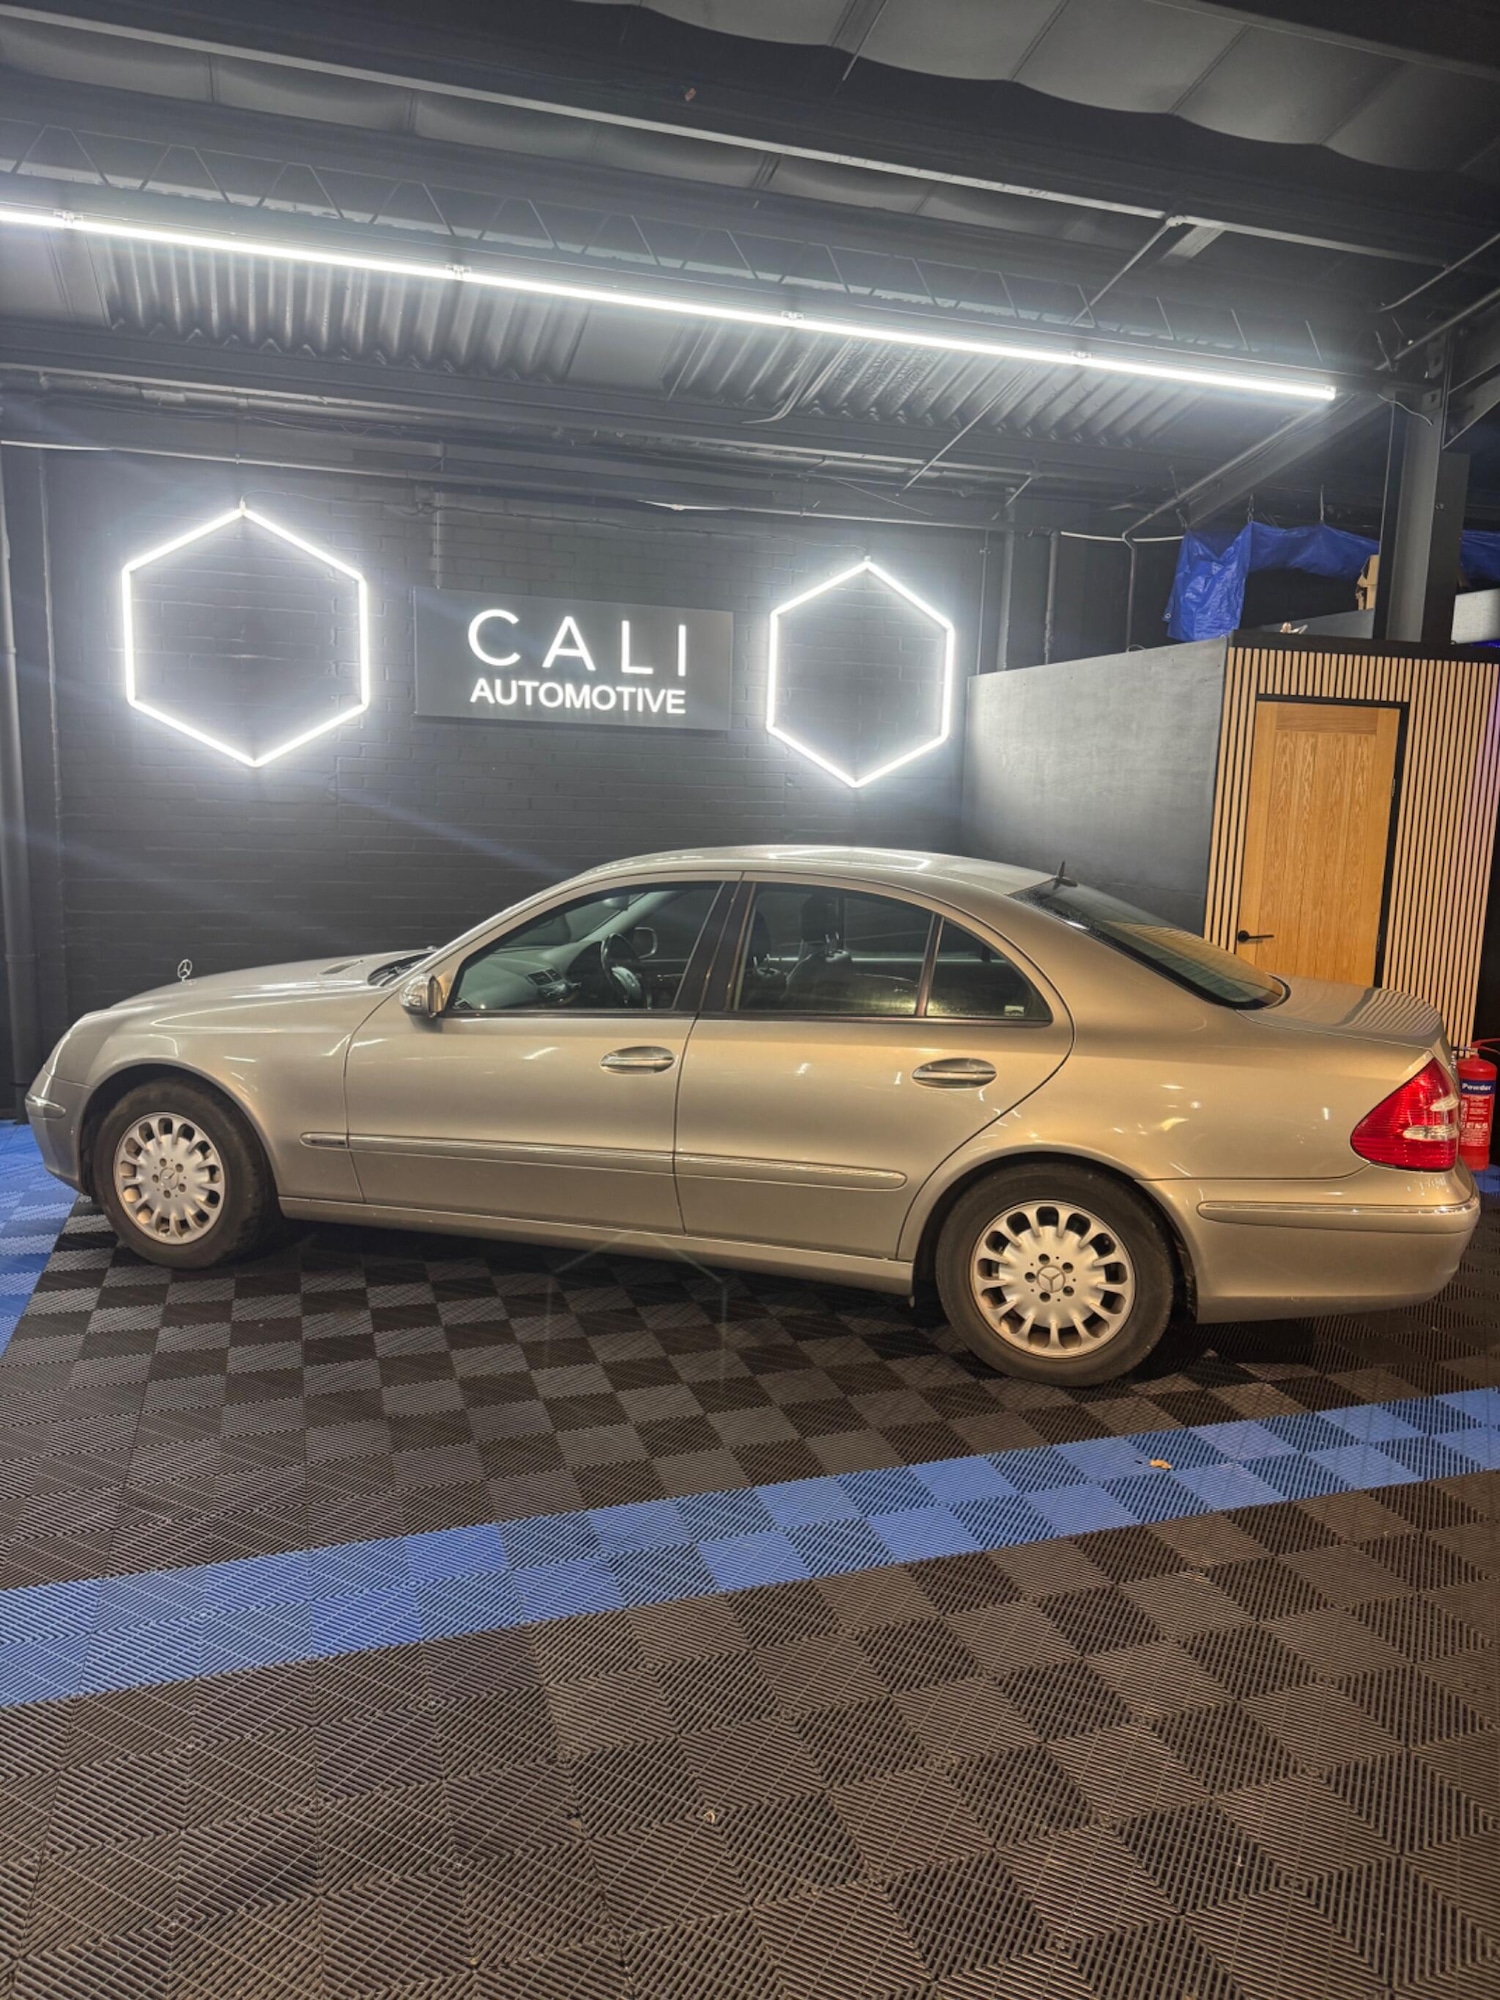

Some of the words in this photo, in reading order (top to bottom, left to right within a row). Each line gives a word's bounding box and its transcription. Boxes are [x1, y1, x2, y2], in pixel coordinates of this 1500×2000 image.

[467, 608, 687, 677] CALI
[469, 677, 687, 714] AUTOMOTIVE
[1461, 1082, 1492, 1091] Powder
